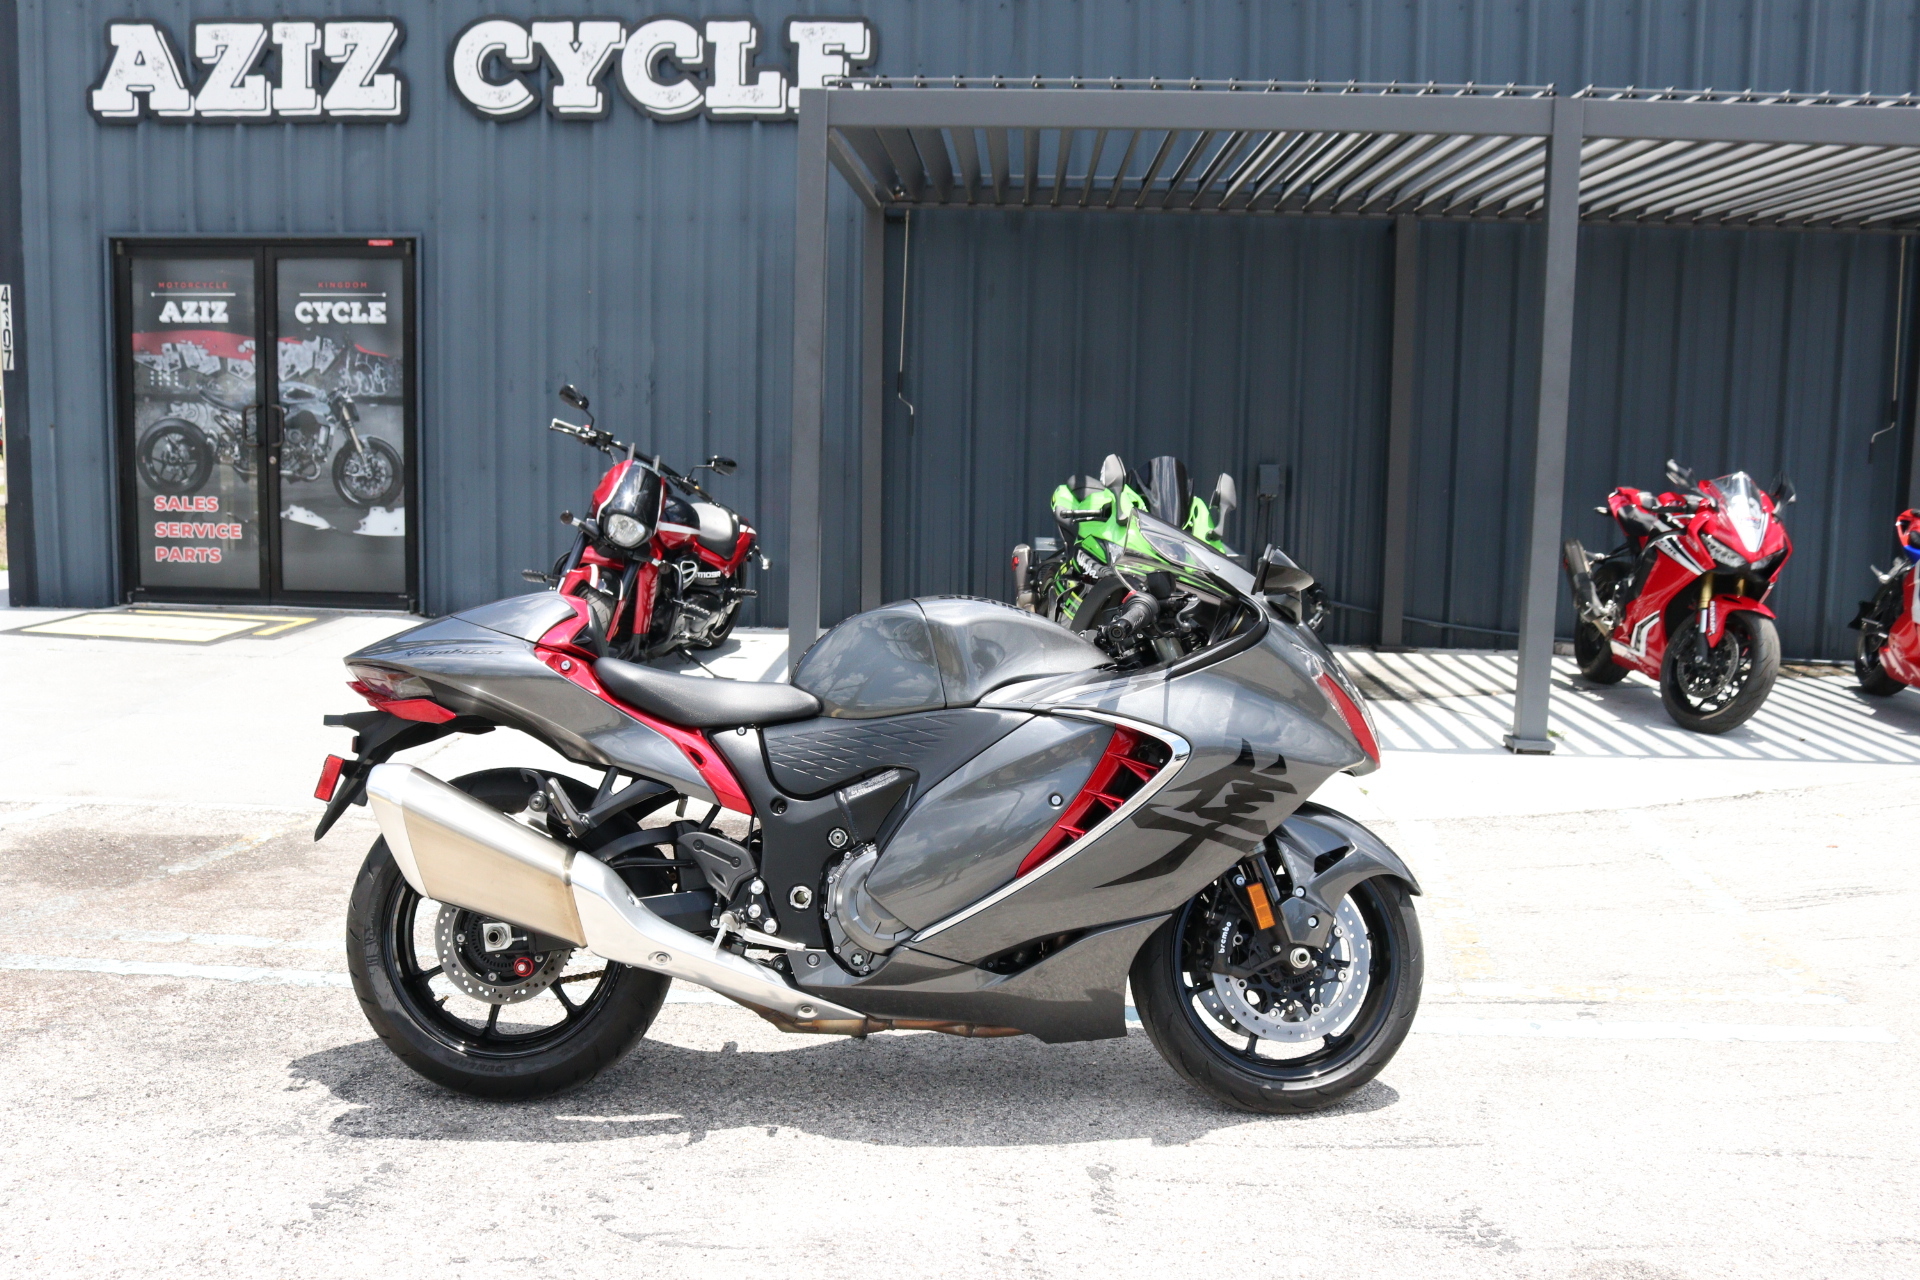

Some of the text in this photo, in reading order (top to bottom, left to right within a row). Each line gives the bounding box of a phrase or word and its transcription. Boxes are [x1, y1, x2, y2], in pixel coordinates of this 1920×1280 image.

[91, 19, 874, 119] AZIZ CYCLE
[158, 281, 229, 289] MOTORCYCLE
[317, 281, 368, 289] KINGDOM
[159, 300, 229, 324] AZIZ
[294, 301, 388, 325] CYCLE
[154, 495, 219, 512] SALES
[154, 523, 243, 539] SERVICE
[155, 547, 222, 563] PARTS
[1218, 921, 1232, 954] brembo
